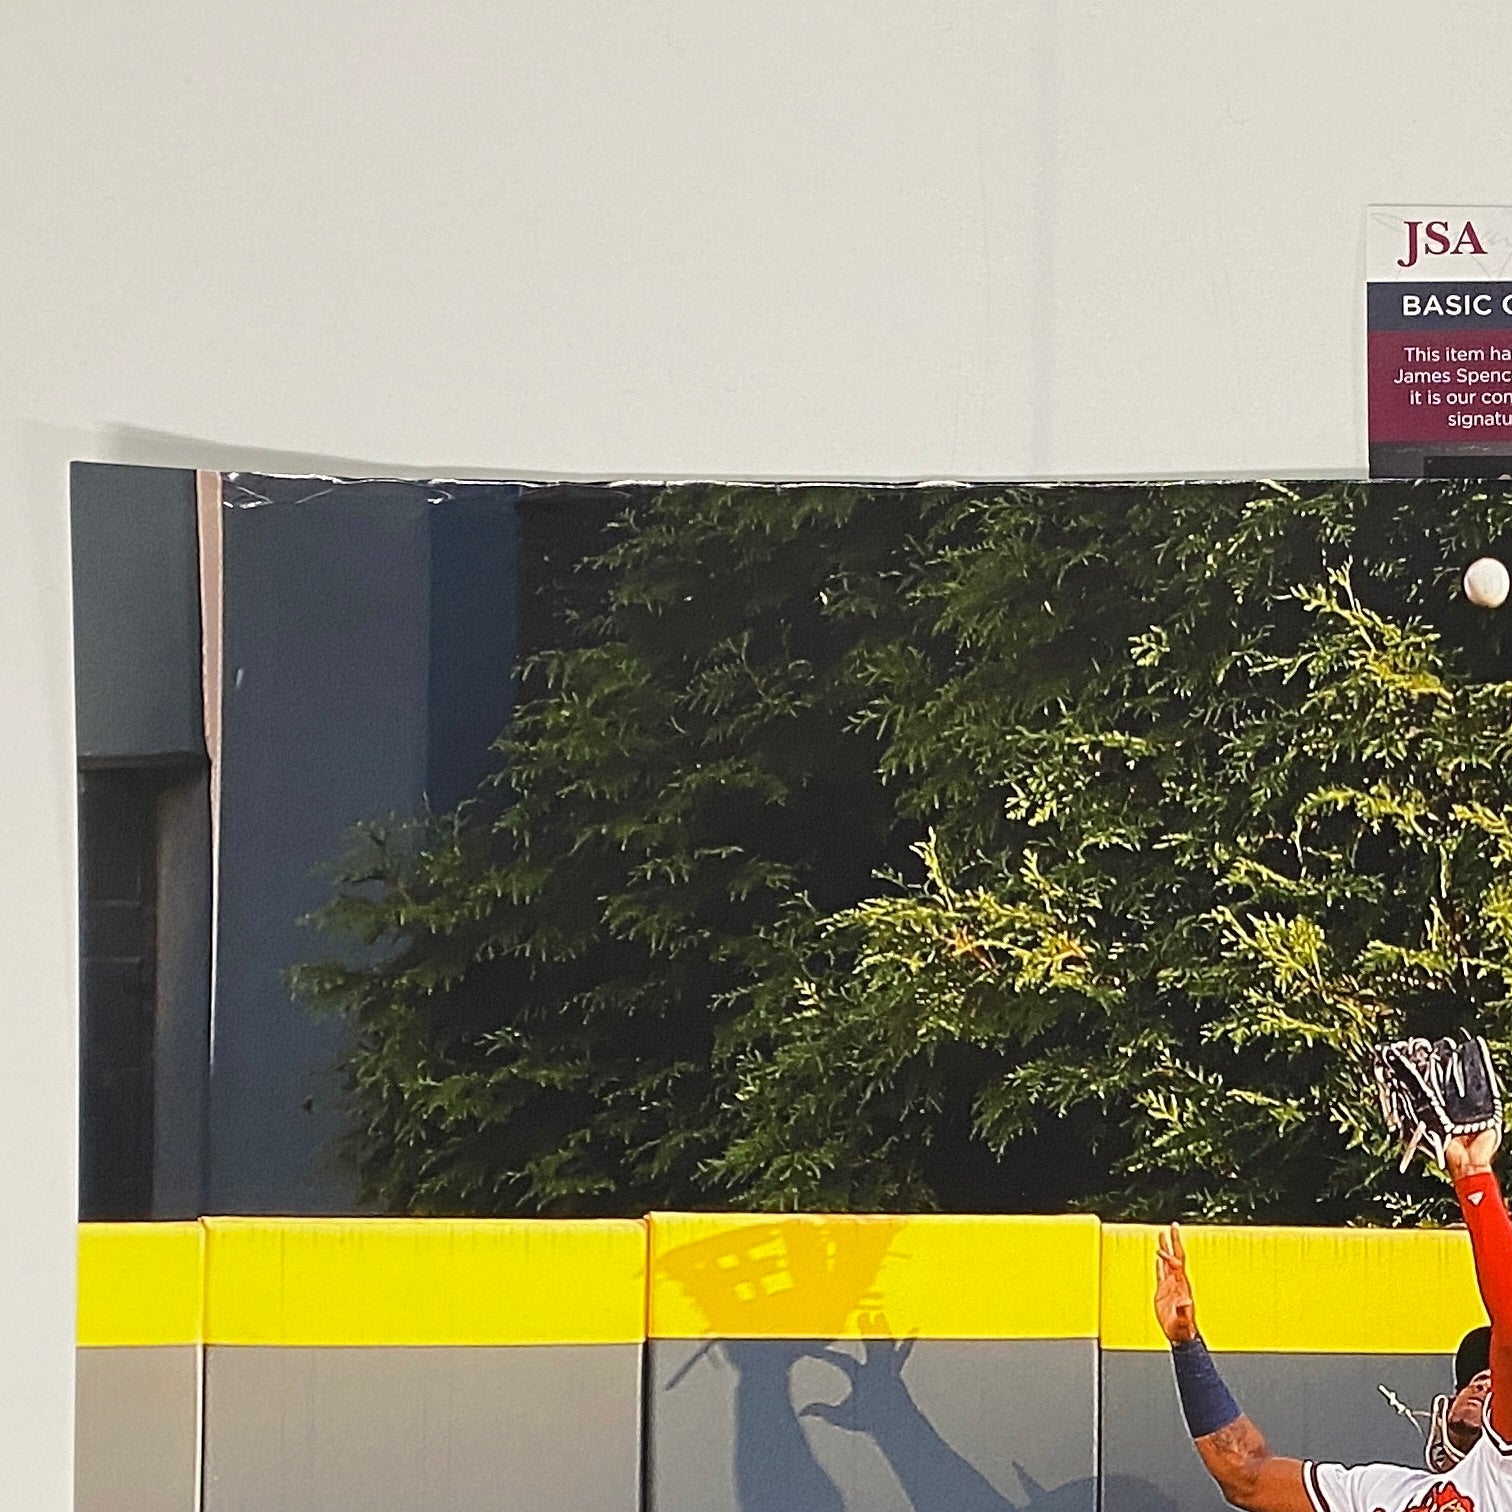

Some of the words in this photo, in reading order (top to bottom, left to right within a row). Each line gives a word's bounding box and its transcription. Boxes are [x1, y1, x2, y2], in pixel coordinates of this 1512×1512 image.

[1397, 220, 1488, 268] JSA
[1402, 294, 1492, 316] BASIC
[1404, 346, 1440, 362] This
[1445, 346, 1485, 361] item
[1394, 368, 1451, 384] James
[1410, 390, 1422, 405] it
[1427, 389, 1441, 405] is
[1446, 392, 1476, 405] our
